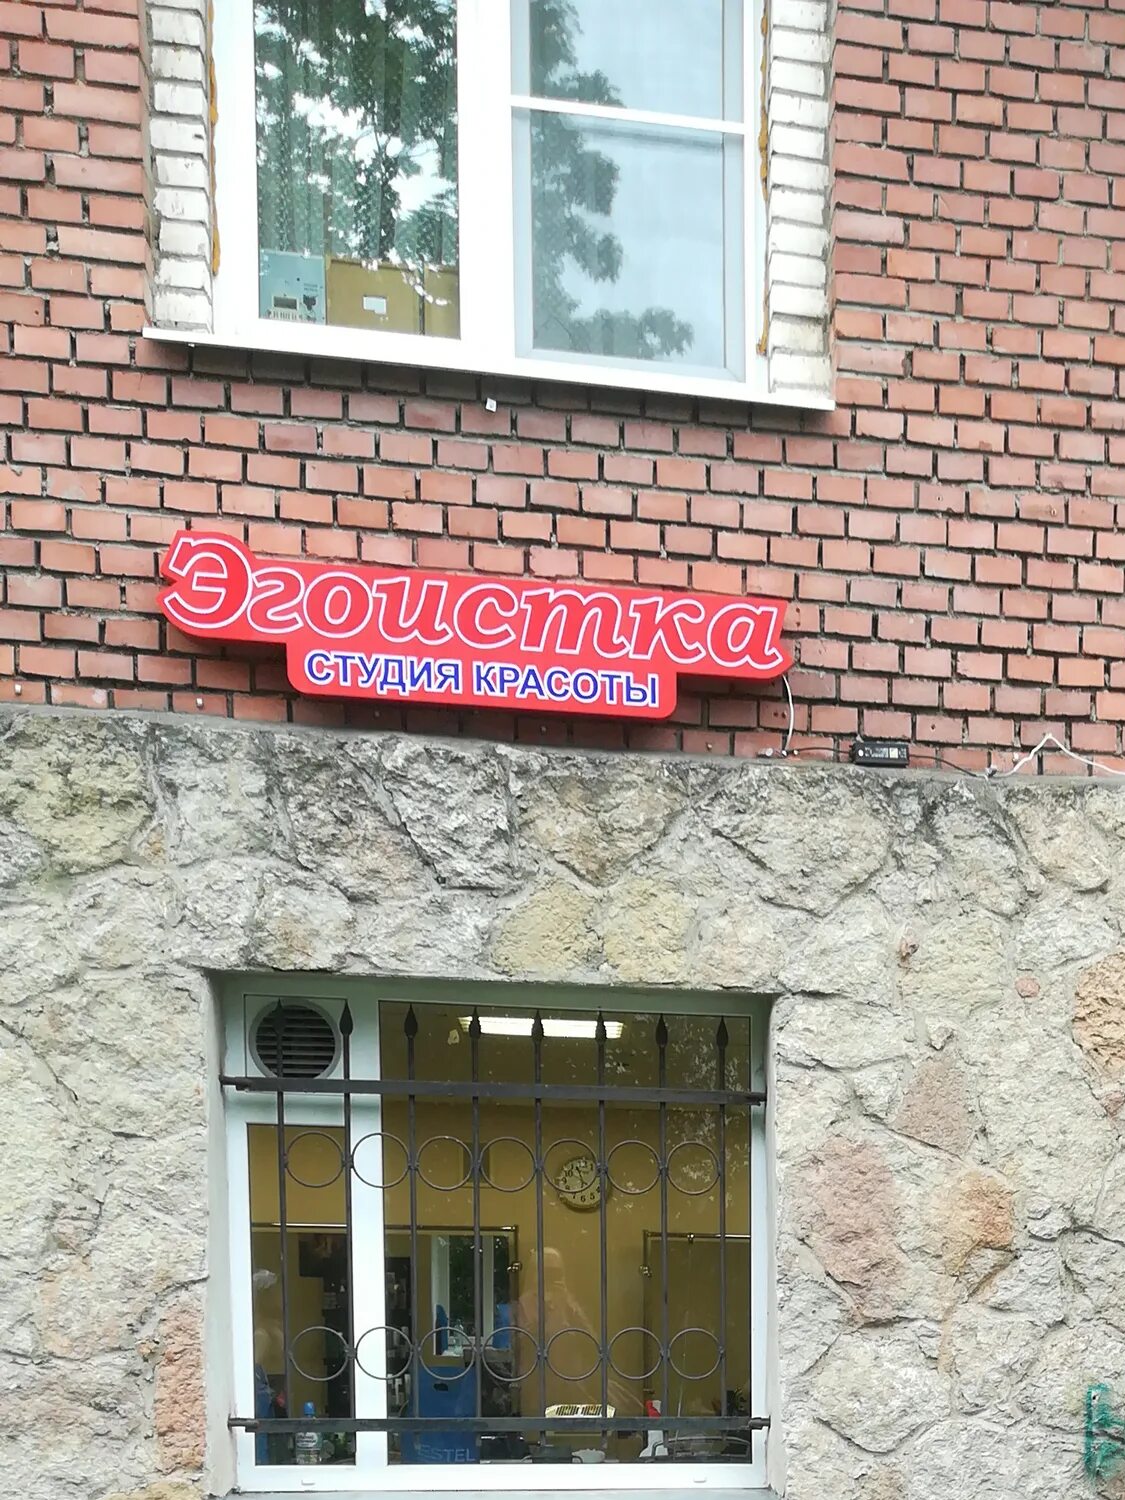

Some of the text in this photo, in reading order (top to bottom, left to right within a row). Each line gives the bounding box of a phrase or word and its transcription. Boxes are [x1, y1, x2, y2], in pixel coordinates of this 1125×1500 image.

[161, 537, 787, 670] Эгоистка
[305, 651, 660, 708] СТУДИЯ КРАСОТЫ
[418, 1444, 477, 1462] ESTEL
